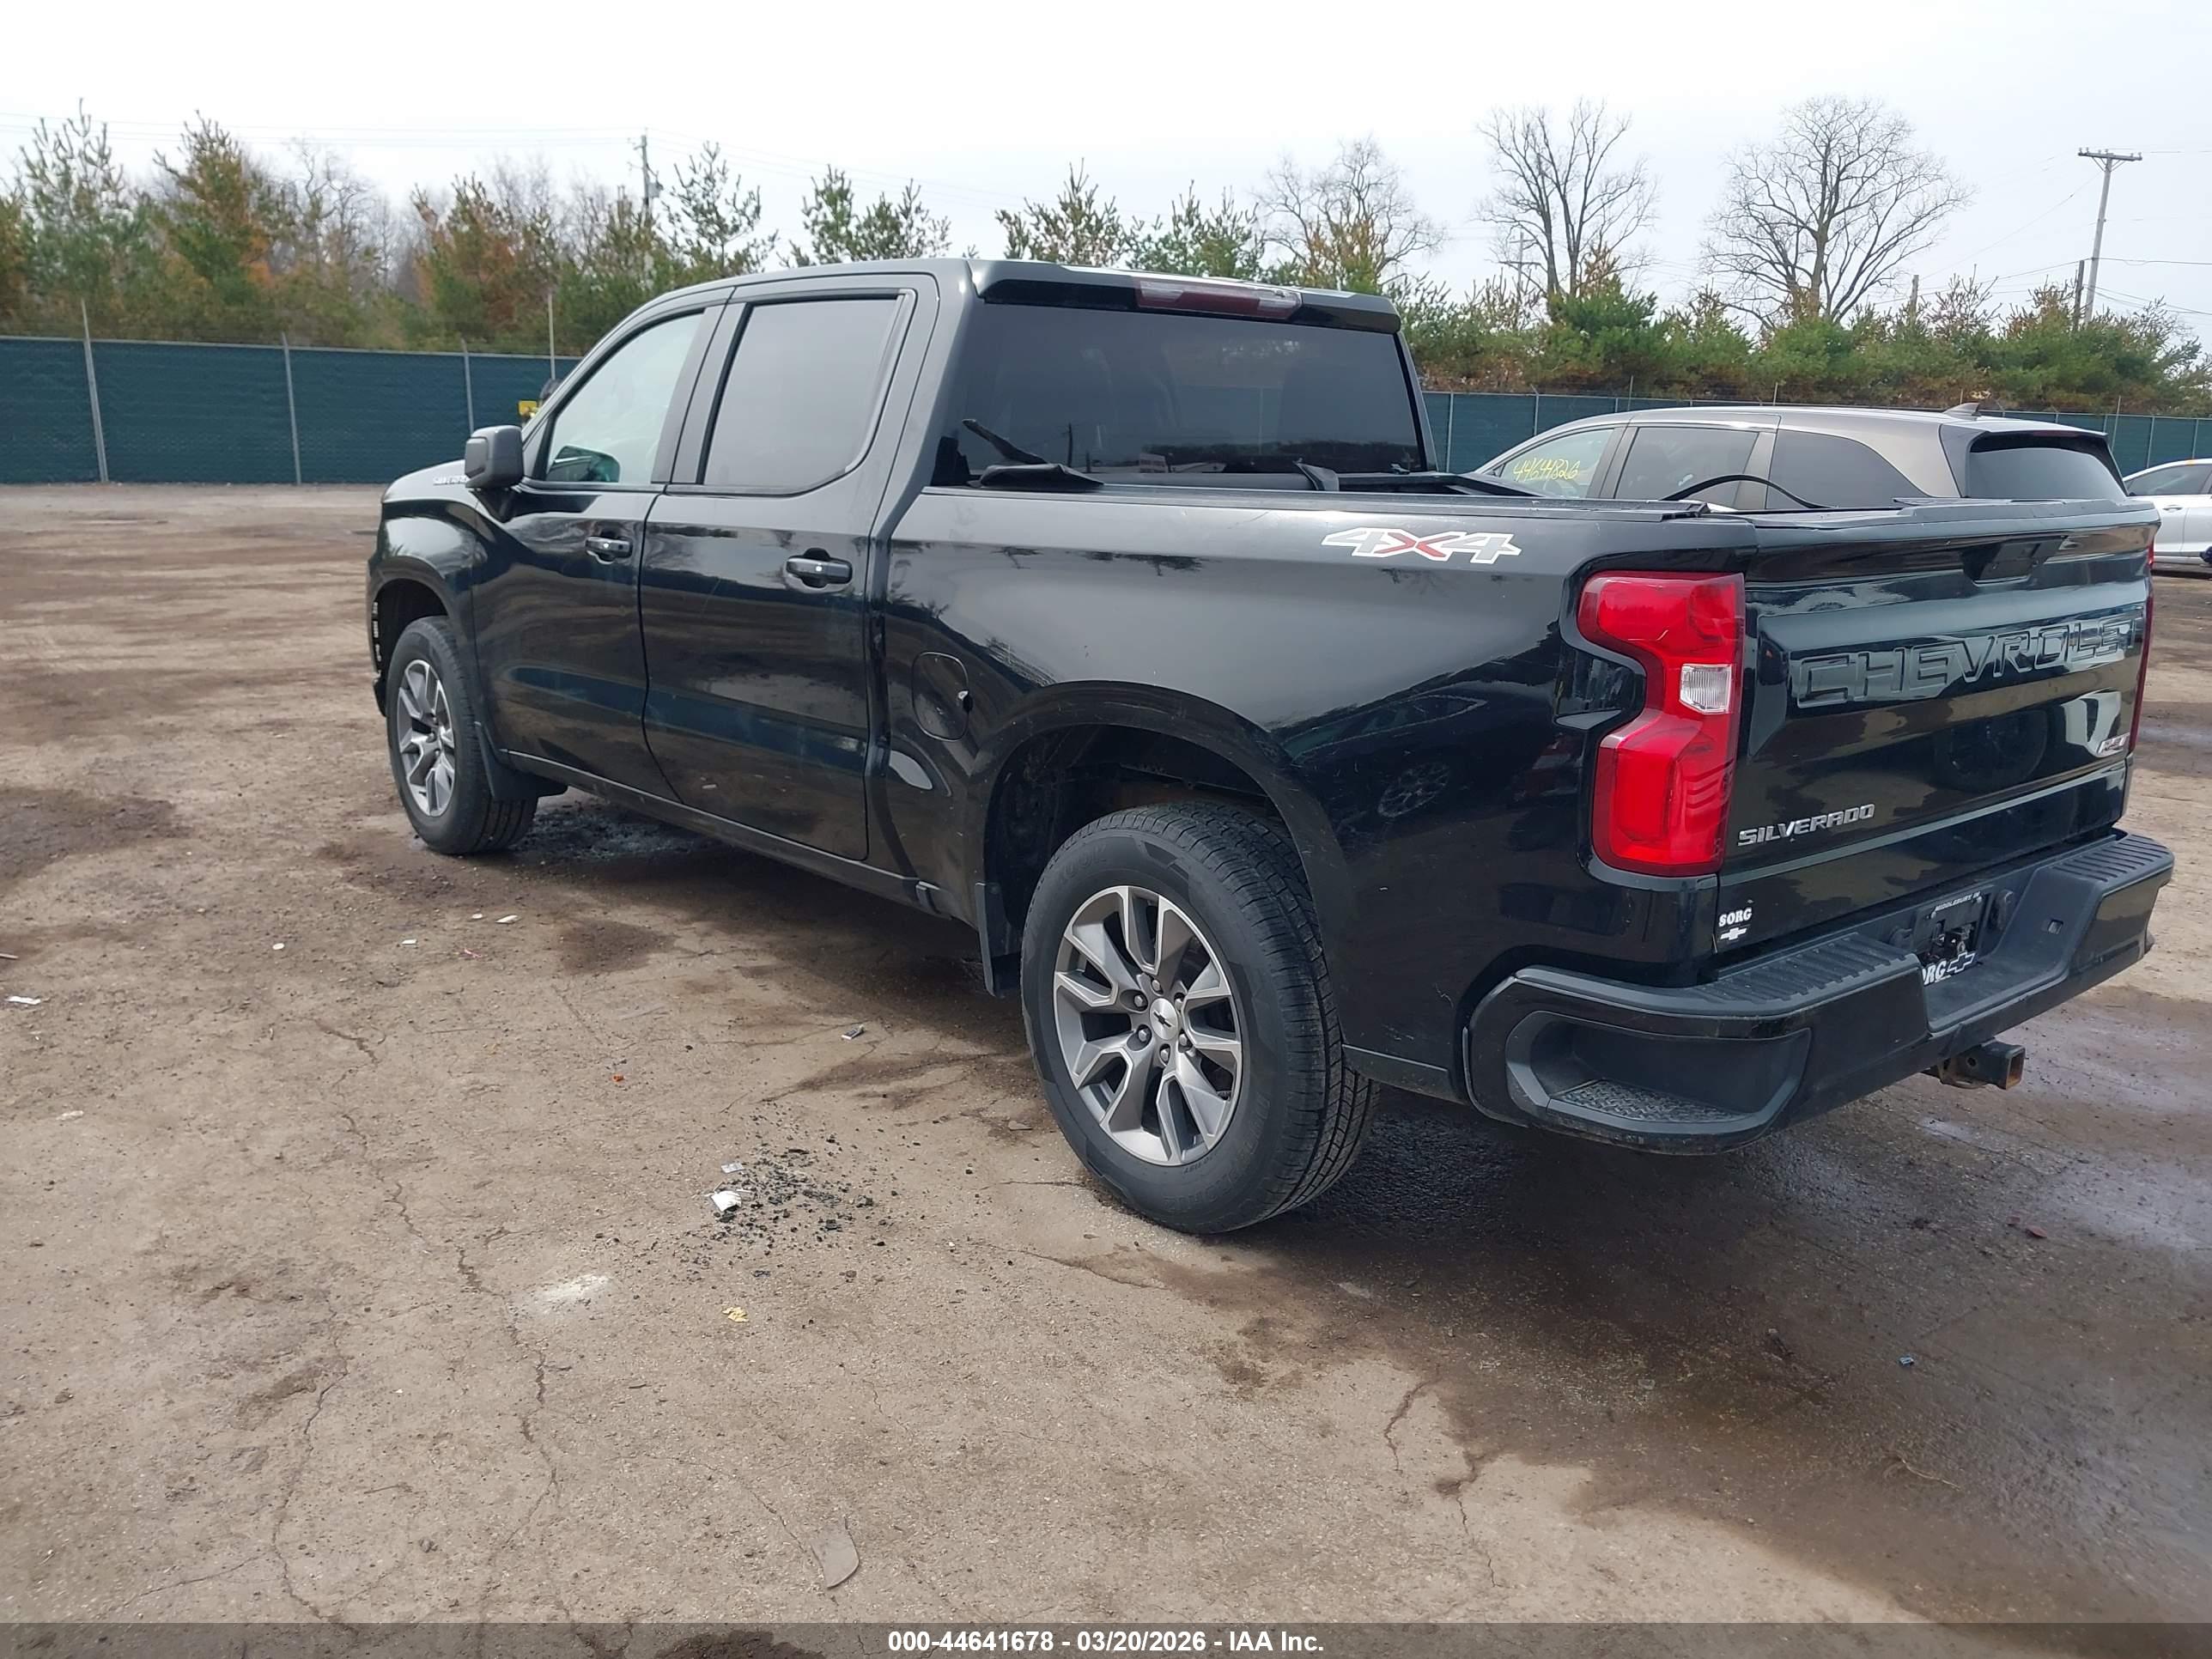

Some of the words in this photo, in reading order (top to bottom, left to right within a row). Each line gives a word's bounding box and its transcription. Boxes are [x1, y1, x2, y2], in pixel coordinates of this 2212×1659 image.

[1513, 458, 1580, 482] 44644826
[1321, 527, 1522, 564] 4X4
[1796, 611, 2143, 708] CHEVROLET
[1737, 804, 1875, 847] SILVERADO
[1718, 907, 1753, 927] SORG
